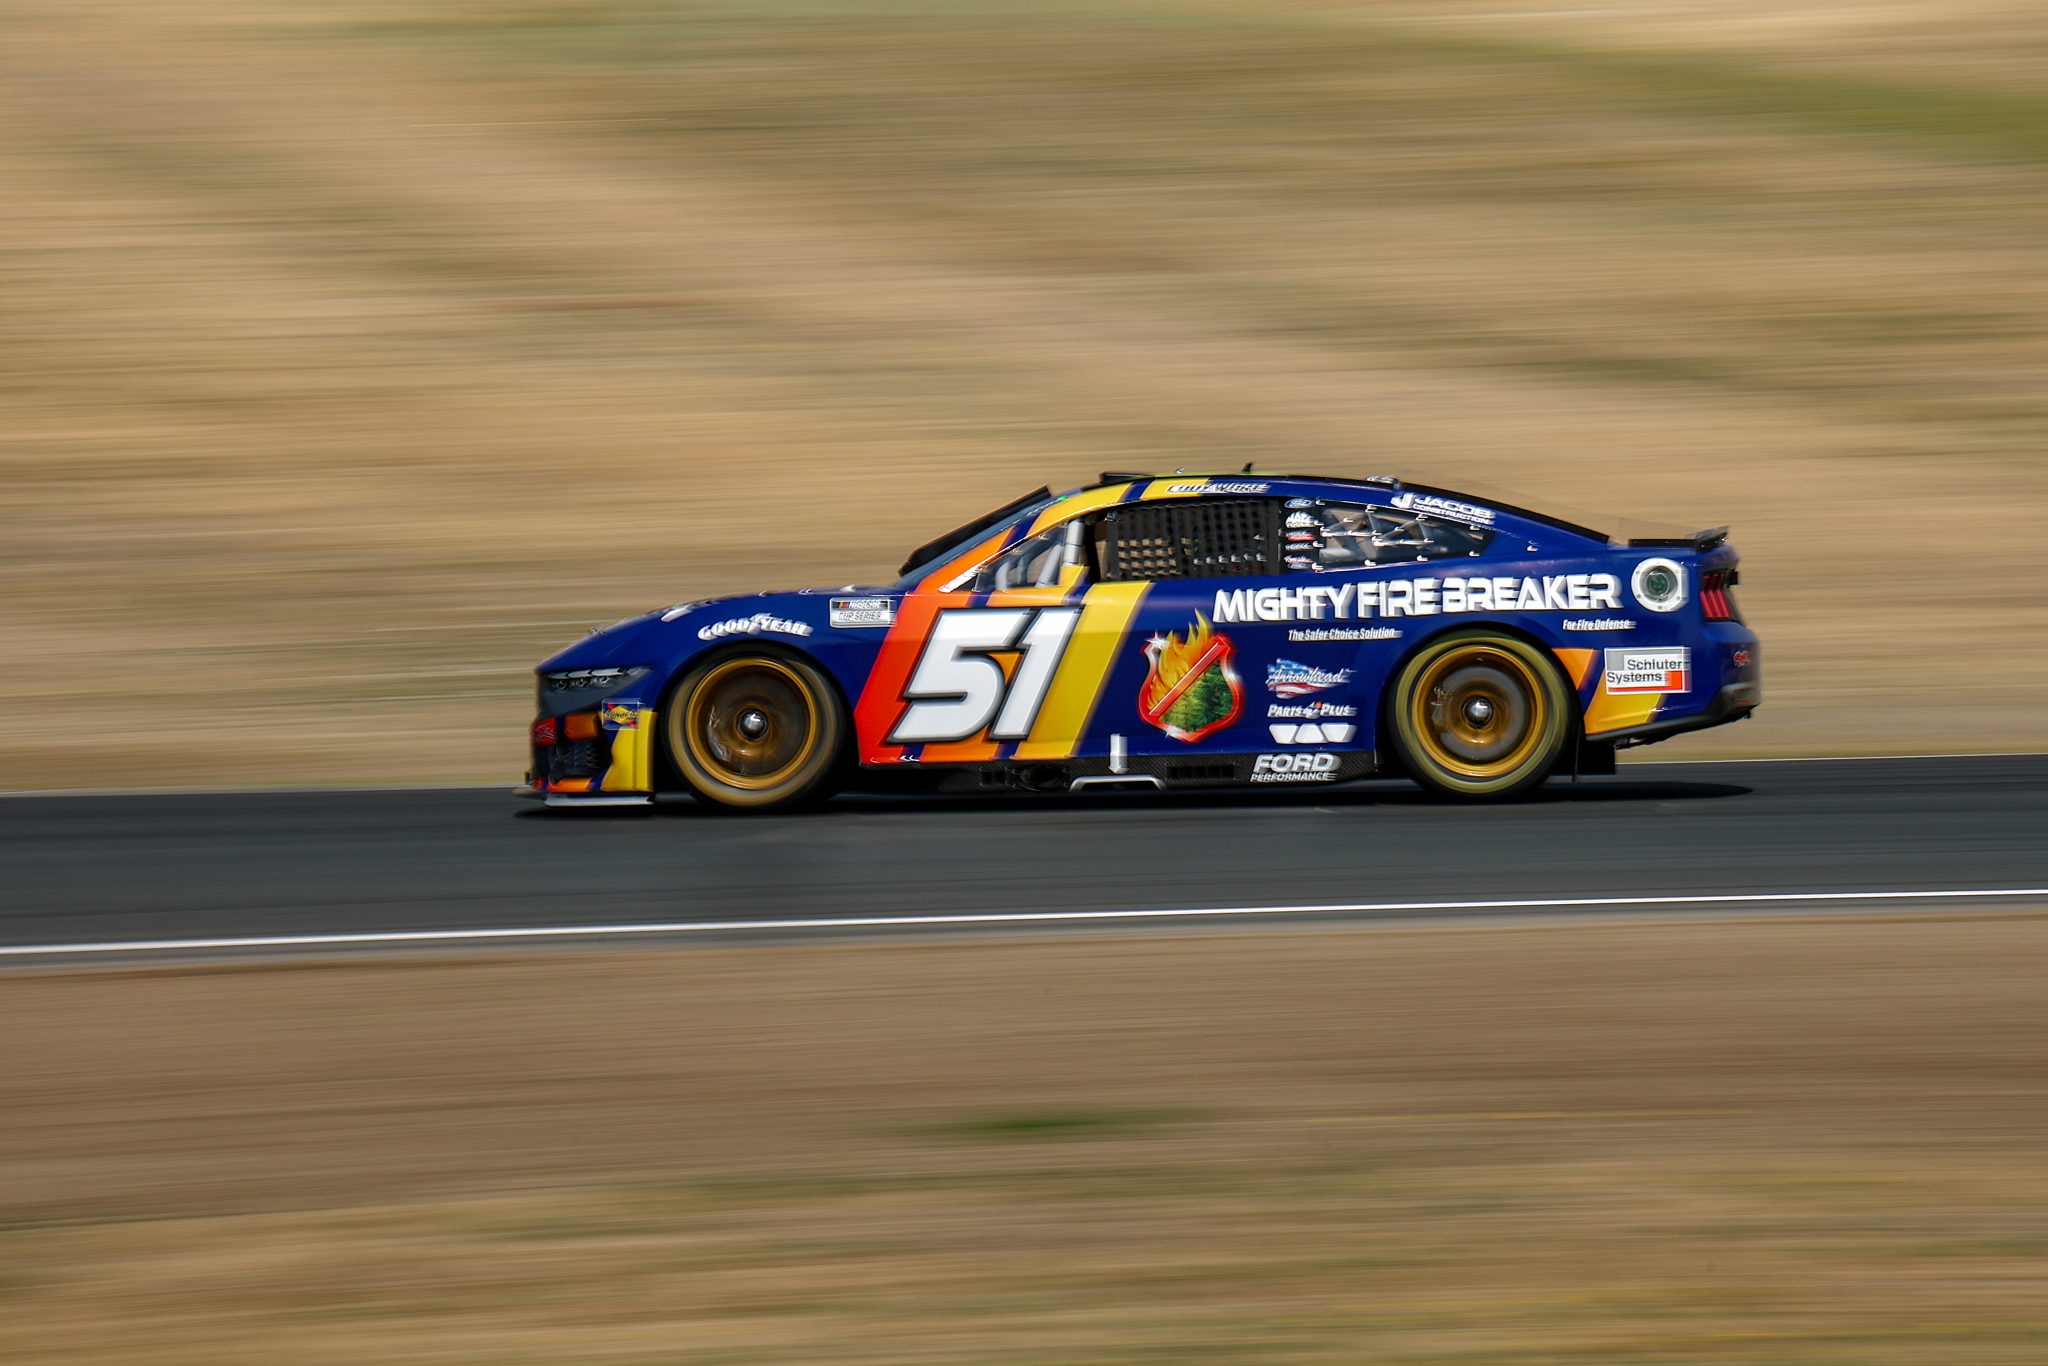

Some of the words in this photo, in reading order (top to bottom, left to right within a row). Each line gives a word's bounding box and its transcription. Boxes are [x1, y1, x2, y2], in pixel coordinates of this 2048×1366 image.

[1412, 503, 1495, 525] CONSTRUCTION
[1415, 496, 1496, 519] JACOB
[1213, 583, 1354, 623] MIGHTY
[1357, 577, 1441, 618] FIRE
[1442, 573, 1624, 613] BREAKER
[854, 611, 882, 620] SERIES
[1562, 619, 1577, 631] For
[1577, 619, 1594, 631] Fire
[1595, 618, 1636, 630] Defense
[698, 613, 814, 641] GOODYEAR
[1288, 629, 1305, 641] The
[1305, 628, 1328, 641] Safer
[1329, 627, 1359, 640] Choice
[1360, 626, 1400, 639] Solution
[1627, 658, 1683, 671] Schluter
[888, 606, 1082, 743] 51
[1265, 666, 1351, 685] Arrowhead
[1606, 671, 1663, 685] Systems
[1252, 753, 1340, 773] FORD
[1250, 772, 1337, 782] PERFORMANCE
